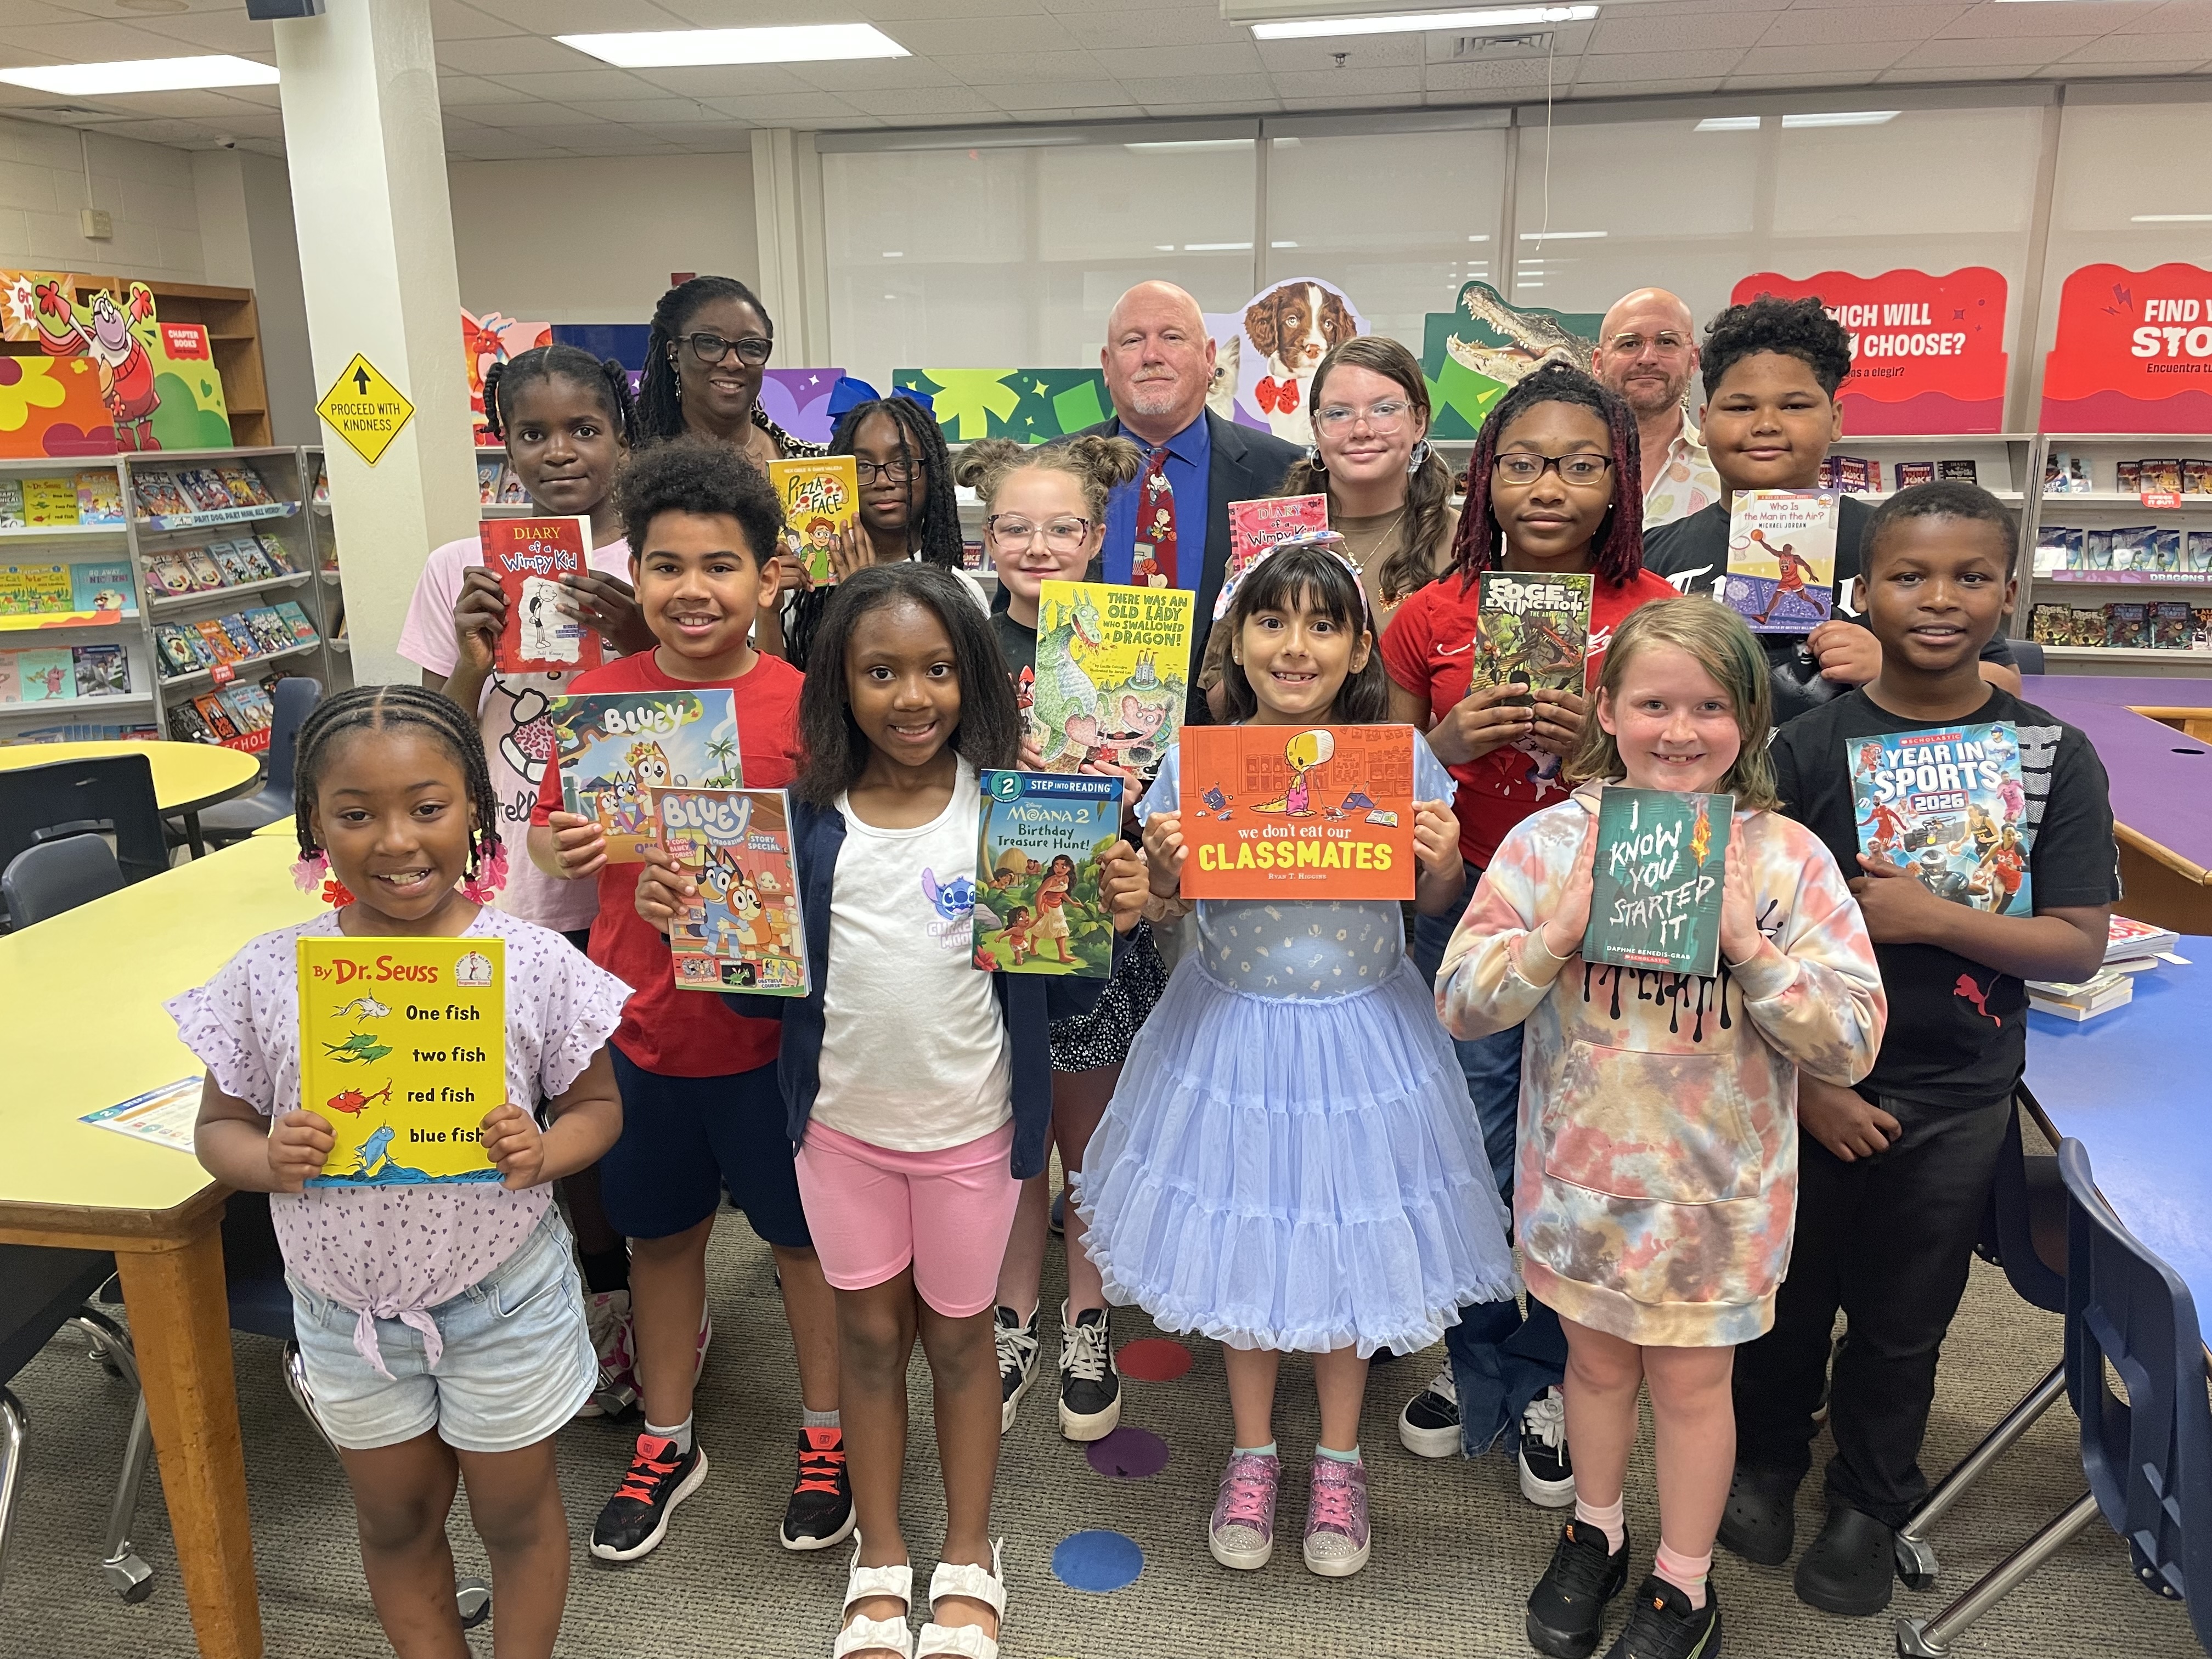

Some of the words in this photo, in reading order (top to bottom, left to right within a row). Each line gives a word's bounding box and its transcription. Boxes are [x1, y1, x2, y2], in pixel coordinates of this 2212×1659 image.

[1825, 305, 1878, 327] HICH
[1883, 303, 1931, 326] WILL
[2145, 300, 2200, 322] FIND
[168, 330, 199, 340] CHAPTER
[174, 338, 197, 348] BOOKS
[2131, 326, 2212, 357] STO
[1864, 332, 1966, 357] CHOOSE?
[1847, 368, 1861, 377] as
[1864, 368, 1869, 377] a
[1871, 366, 1905, 378] elegir?
[2147, 363, 2200, 373] Encuentra
[331, 403, 375, 415] PROCEED
[377, 403, 400, 415] WITH
[343, 419, 392, 431] KINDNESS
[1842, 471, 1865, 481] JOKE
[1904, 476, 1931, 484] JOKE
[811, 494, 842, 515] FACE
[1258, 504, 1302, 520] DIARY
[194, 515, 210, 523] PART
[1271, 520, 1280, 528] of
[1805, 512, 1824, 520] Air?
[514, 527, 561, 540] DIARY
[529, 541, 541, 552] of
[500, 552, 553, 574] Wimpy
[554, 550, 577, 569] Kid
[2150, 574, 2204, 582] DRAGONS
[1488, 578, 1565, 601] EDGE
[1107, 592, 1140, 605] THERE
[1144, 595, 1166, 606] WAS
[1170, 596, 1187, 607] AN
[1486, 597, 1583, 616] EXTINCTION
[1108, 605, 1138, 619] OLD
[1146, 606, 1182, 621] LADY
[1122, 621, 1184, 632] SWALLOWED
[1113, 631, 1181, 646] DRAGON!
[604, 704, 684, 740] BLUEY
[1908, 734, 1960, 744] SCHOLASTIC
[1886, 743, 1952, 769] YEAR
[1957, 741, 1985, 762] IN
[1002, 778, 1014, 794] 2
[1031, 780, 1053, 790] STEP
[1069, 783, 1110, 793] READING
[1874, 760, 2003, 803] SPORTS
[1915, 793, 1965, 811] 2026
[663, 796, 749, 839] BLUEY
[1007, 806, 1073, 822] MOANA
[1075, 809, 1090, 823] 2
[1630, 798, 1639, 833] I
[1019, 823, 1074, 840] Birthday
[1238, 829, 1258, 839] we
[1262, 823, 1295, 838] don't
[1300, 825, 1322, 838] eat
[1327, 828, 1352, 839] our
[713, 836, 744, 847] magazine
[997, 836, 1048, 848] Treasure
[1053, 838, 1090, 850] Hunt!
[1609, 820, 1682, 877] KNOW
[1199, 841, 1392, 871] CLASSMATES
[1629, 850, 1679, 896] YOU
[1609, 875, 1716, 928] STARTED
[927, 919, 971, 936] CURRE
[1660, 913, 1687, 950] IT
[940, 933, 973, 949] MOO
[1606, 945, 1635, 954] DAPHNE
[1638, 949, 1690, 960] BENEDIS-GRAB
[1630, 956, 1669, 964] SCHOLASTIC
[312, 966, 332, 980] By
[332, 959, 372, 984] Dr.
[376, 955, 438, 984] Seuss
[406, 1005, 439, 1020] One
[445, 1005, 480, 1020] fish
[413, 1048, 447, 1062] two
[452, 1046, 486, 1062] fish
[408, 1088, 435, 1102] red
[441, 1088, 475, 1102] fish
[410, 1128, 446, 1143] blue
[452, 1128, 484, 1143] fish
